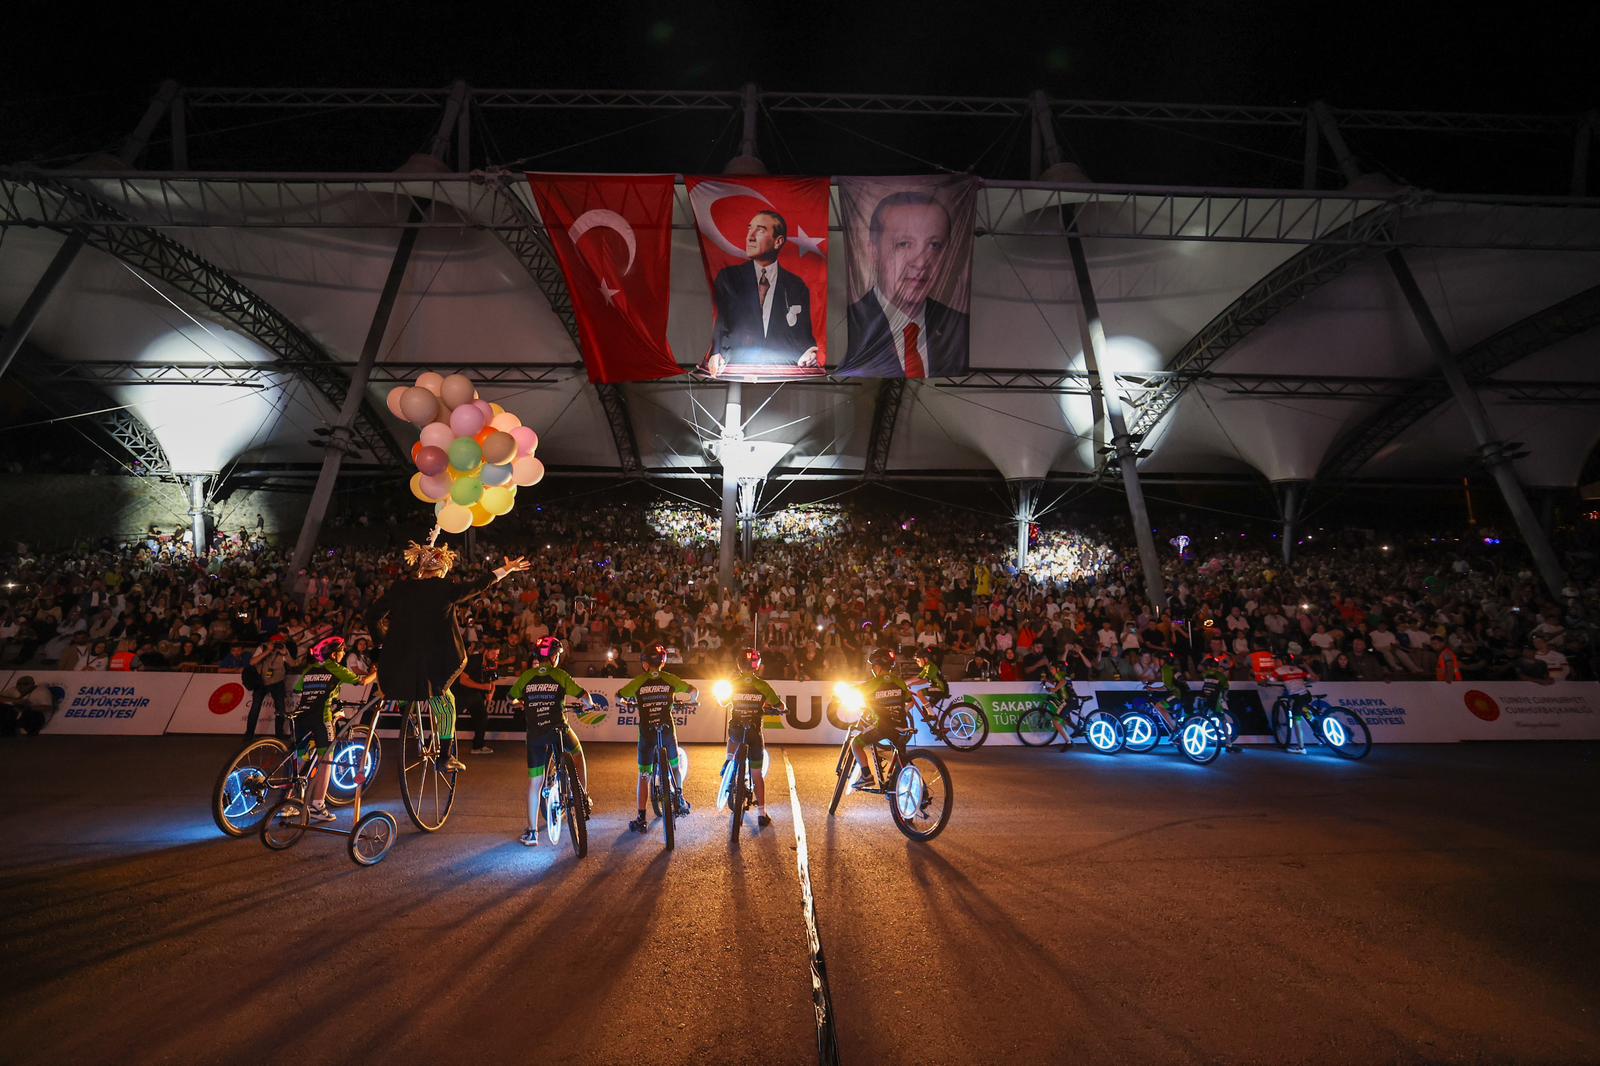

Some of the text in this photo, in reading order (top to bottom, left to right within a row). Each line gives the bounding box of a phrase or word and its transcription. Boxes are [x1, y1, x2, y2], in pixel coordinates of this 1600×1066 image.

[78, 686, 136, 696] SAKARYA
[526, 683, 559, 693] SAKARYA
[640, 685, 671, 695] SAKARYA
[71, 696, 151, 708] BÜYÜKŞEHİR
[991, 701, 1041, 712] SAKARY
[1338, 698, 1387, 707] SAKARYA
[64, 708, 138, 719] BELEDİYESİ
